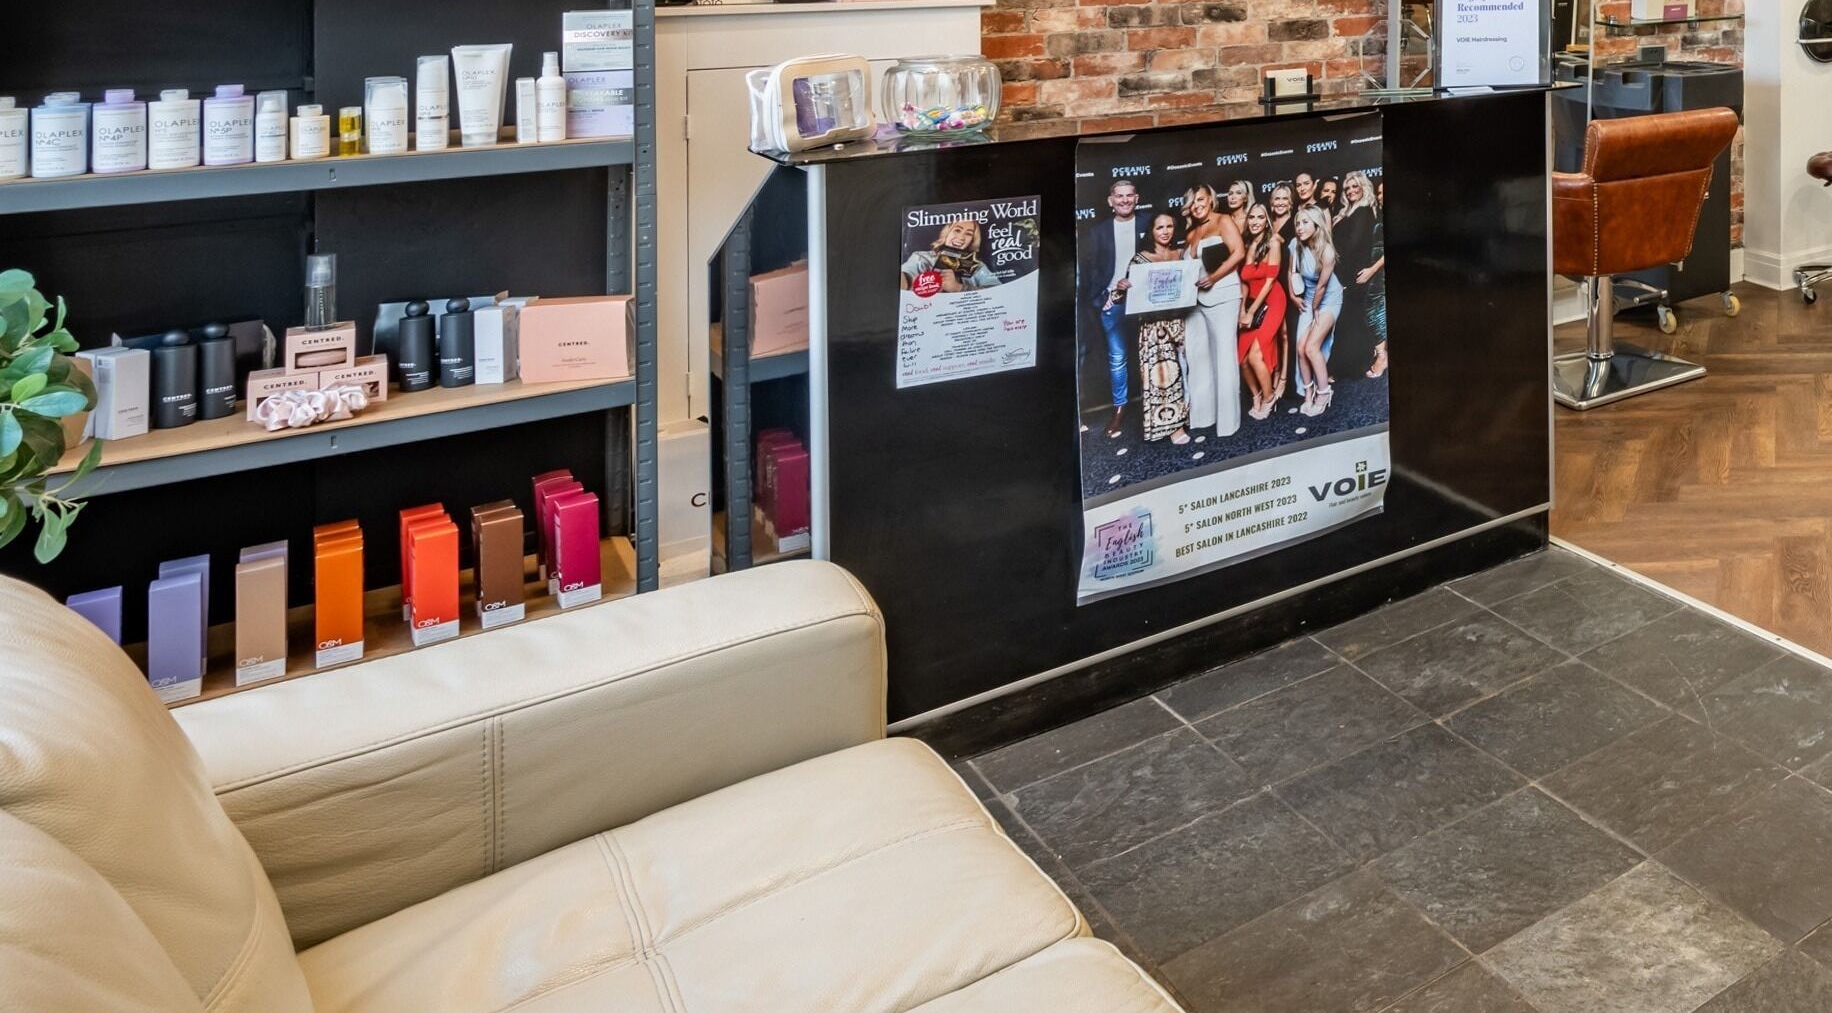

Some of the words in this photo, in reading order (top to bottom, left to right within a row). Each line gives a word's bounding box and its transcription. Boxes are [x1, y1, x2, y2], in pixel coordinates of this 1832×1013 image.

[1457, 1, 1524, 12] Recommended
[1456, 14, 1479, 23] 2023
[574, 29, 620, 38] DISCOVERY
[1472, 35, 1508, 43] Hairdressing
[36, 129, 84, 139] OLAPLEX
[1112, 165, 1151, 174] OCEANIC
[907, 208, 989, 228] Slimming
[990, 200, 1037, 219] World
[988, 222, 1013, 239] feel
[991, 229, 1023, 250] real
[996, 245, 1032, 266] good
[919, 273, 936, 286] free
[302, 336, 344, 345] CENTRED.
[1190, 494, 1217, 511] SALON
[1219, 481, 1270, 503] LANCASHIRE
[1271, 476, 1292, 488] 2023
[1196, 513, 1223, 530] SALON
[1225, 506, 1252, 522] NORTH
[1254, 501, 1275, 513] WEST
[1276, 494, 1298, 507] 2023
[1117, 522, 1132, 531] THE
[1105, 522, 1144, 551] English
[1175, 543, 1195, 558] BEST
[1196, 532, 1223, 551] SALON
[1225, 533, 1235, 543] IN
[1236, 517, 1286, 539] LANCASHIRE
[1287, 511, 1309, 525] 2022
[1103, 550, 1143, 565] INDUSTRY
[1104, 542, 1144, 559] BEAUTY
[1102, 561, 1129, 571] AWARDS
